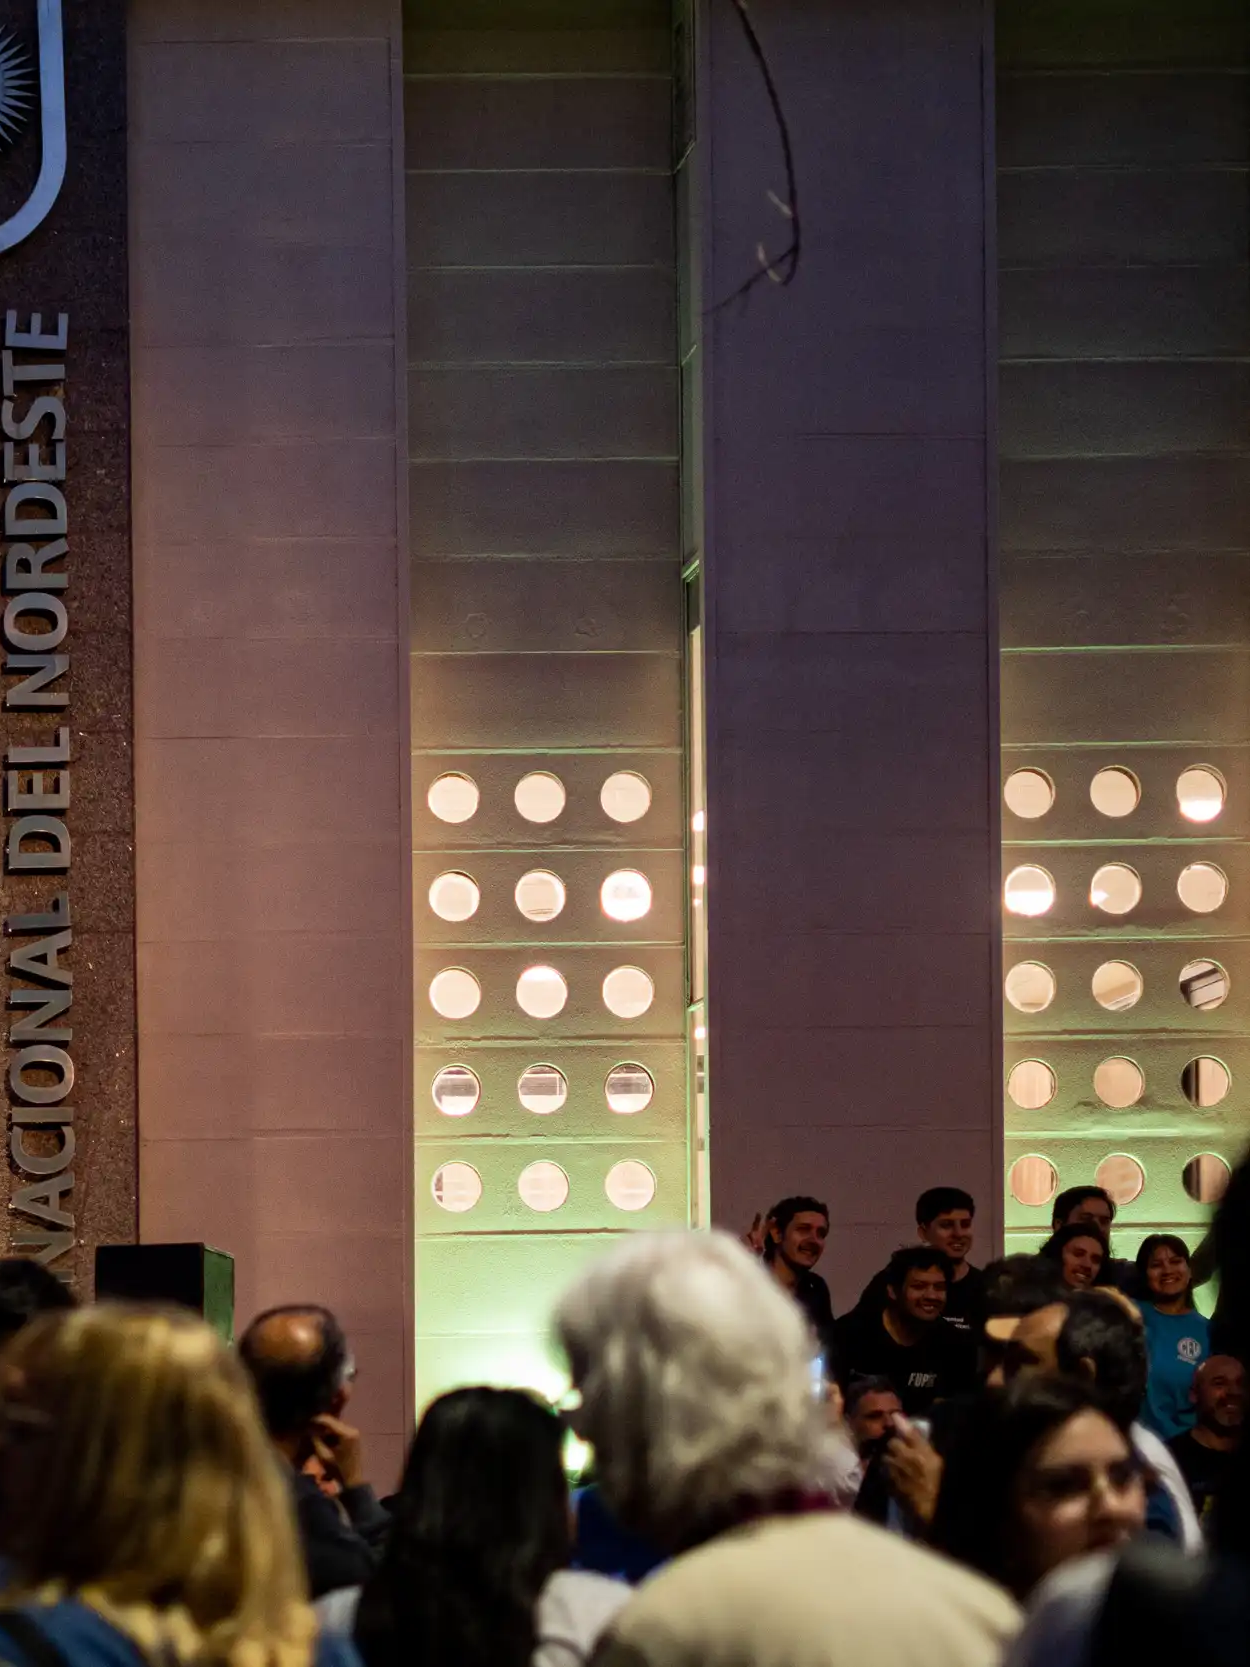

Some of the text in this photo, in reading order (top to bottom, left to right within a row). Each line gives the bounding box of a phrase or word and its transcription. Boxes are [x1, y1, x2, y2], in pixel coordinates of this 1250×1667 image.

[1, 309, 76, 1284] NACIONAL DEL NORDESTE
